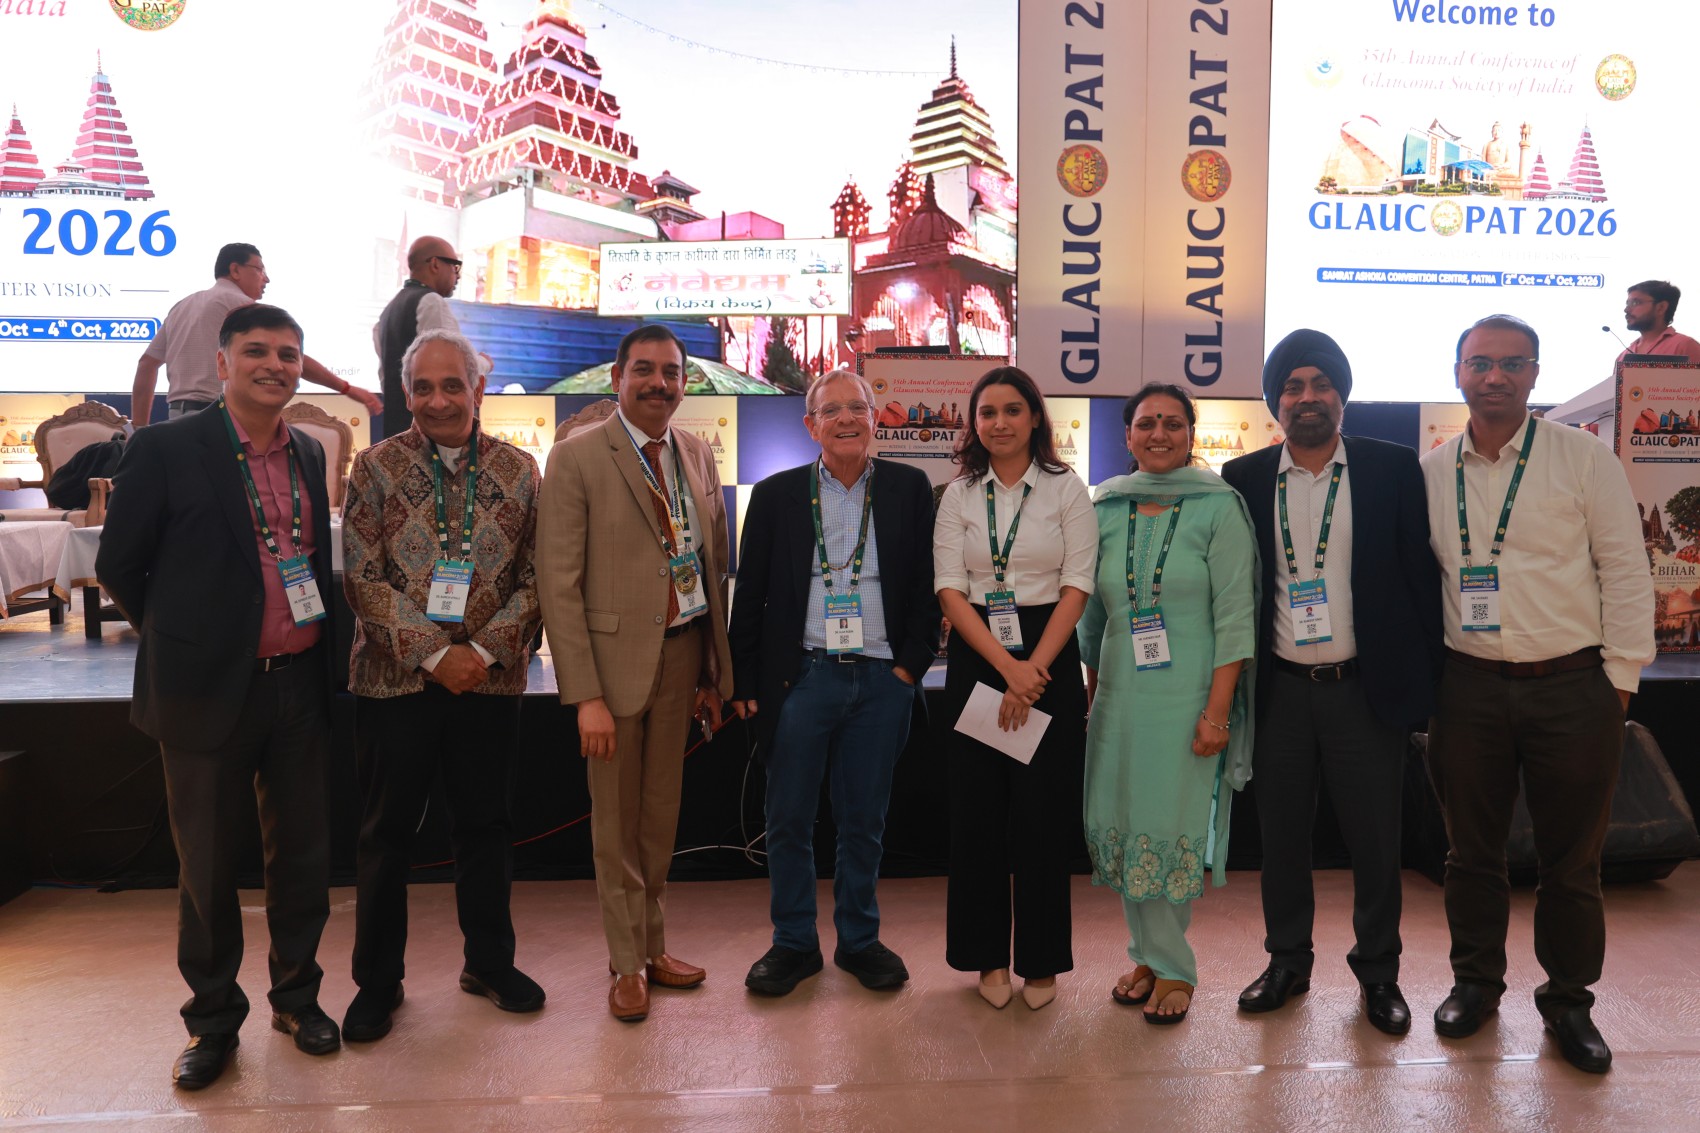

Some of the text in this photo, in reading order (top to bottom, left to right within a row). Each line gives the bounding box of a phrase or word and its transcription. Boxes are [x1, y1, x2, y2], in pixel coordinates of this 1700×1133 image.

[142, 2, 168, 14] PAT
[1392, 0, 1556, 27] Welcome to
[1401, 50, 1466, 66] Annual
[1470, 52, 1558, 72] Conference
[1561, 54, 1581, 72] of
[1362, 72, 1575, 98] Glaucoma Society of India
[1536, 208, 1618, 236] 2026
[22, 208, 177, 257] 2026
[644, 248, 652, 262] के
[1322, 270, 1355, 280] SAMRAT
[1354, 272, 1387, 282] ASHOKA
[1387, 272, 1438, 284] CONVENTION
[1470, 274, 1496, 284] PATNA
[1518, 276, 1535, 286] Oct
[1577, 276, 1598, 286] 2026
[43, 283, 112, 298] VISION
[0, 322, 29, 336] Oct
[71, 322, 106, 340] Oct,
[110, 322, 150, 338] 2026
[1658, 566, 1696, 576] BIHAR
